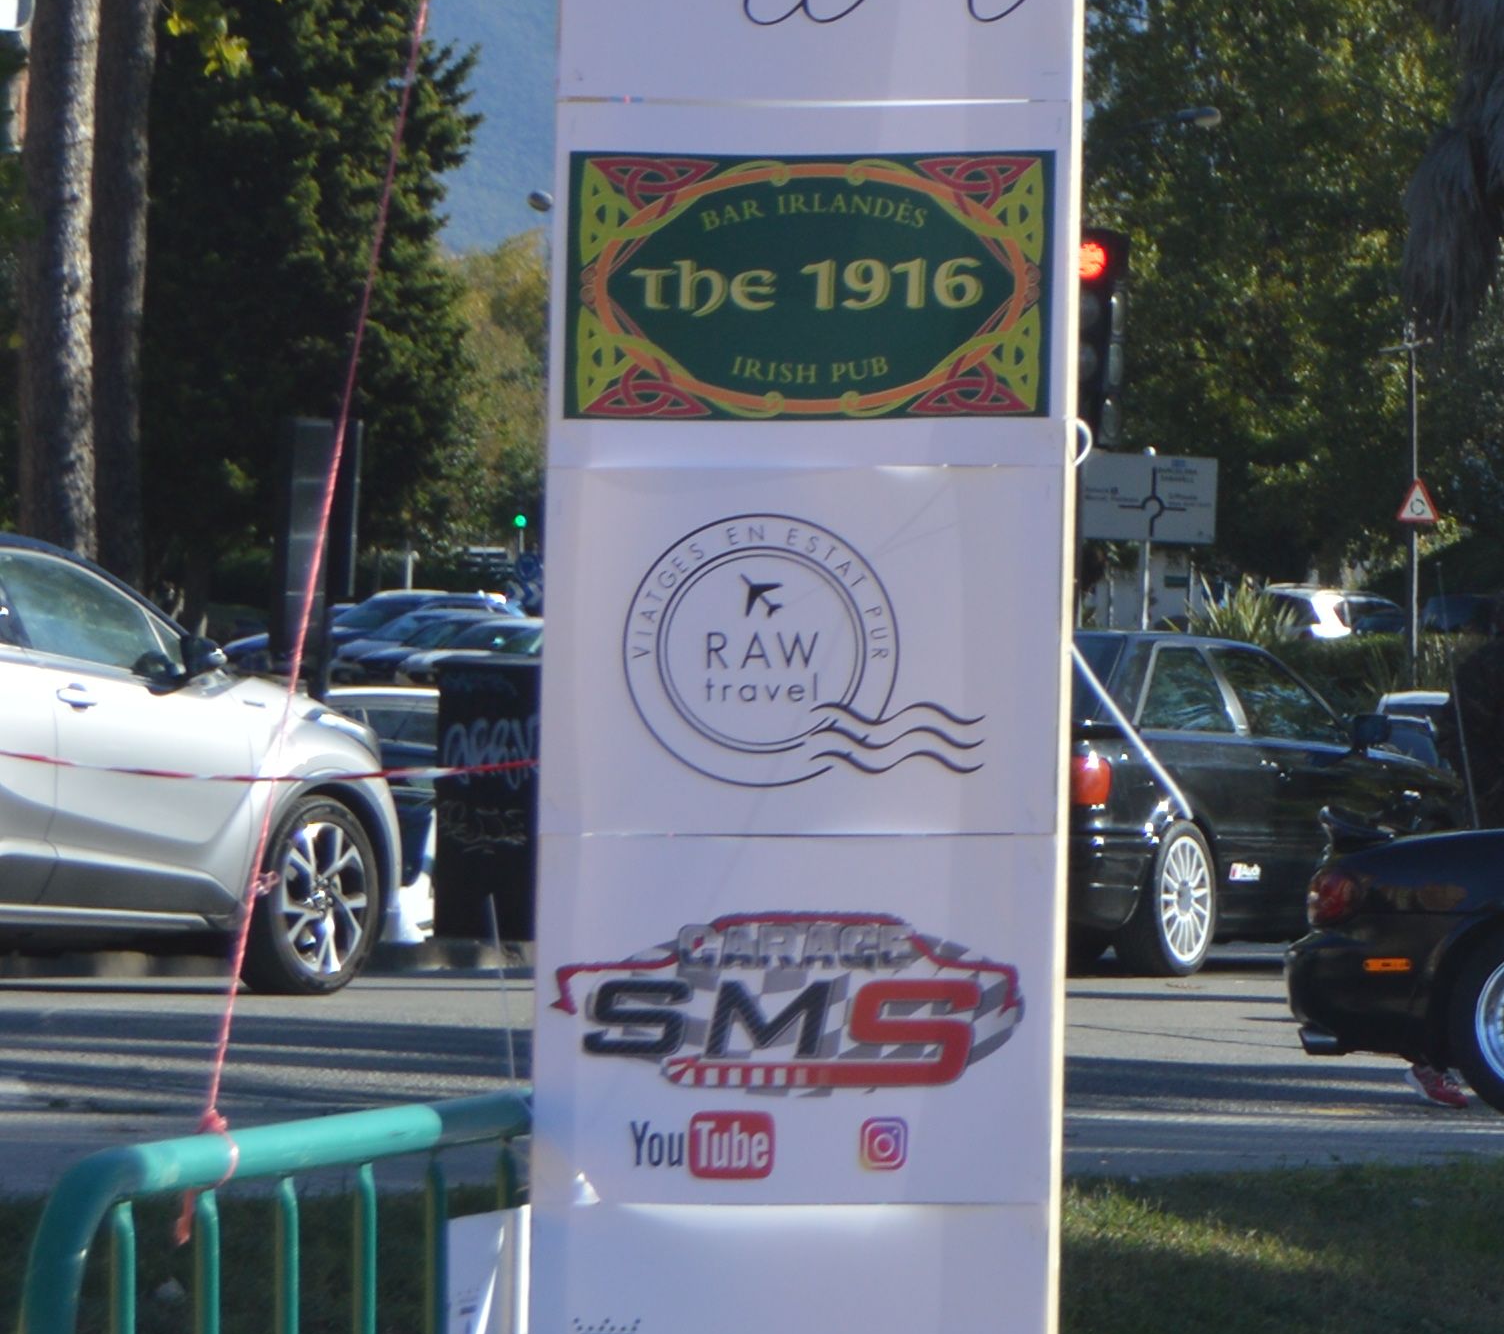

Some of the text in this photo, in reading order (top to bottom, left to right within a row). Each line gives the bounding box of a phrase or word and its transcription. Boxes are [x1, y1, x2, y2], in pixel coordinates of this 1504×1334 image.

[700, 199, 764, 233] BAR
[799, 257, 983, 311] 1916
[730, 354, 889, 385] IRISH PUB
[632, 524, 889, 660] VIATGES EN ESTAT PUR
[705, 631, 819, 669] RAW
[704, 672, 819, 702] travel
[676, 922, 917, 969] GARAGE
[581, 977, 984, 1088] SMS
[629, 1117, 771, 1170] YouTube
